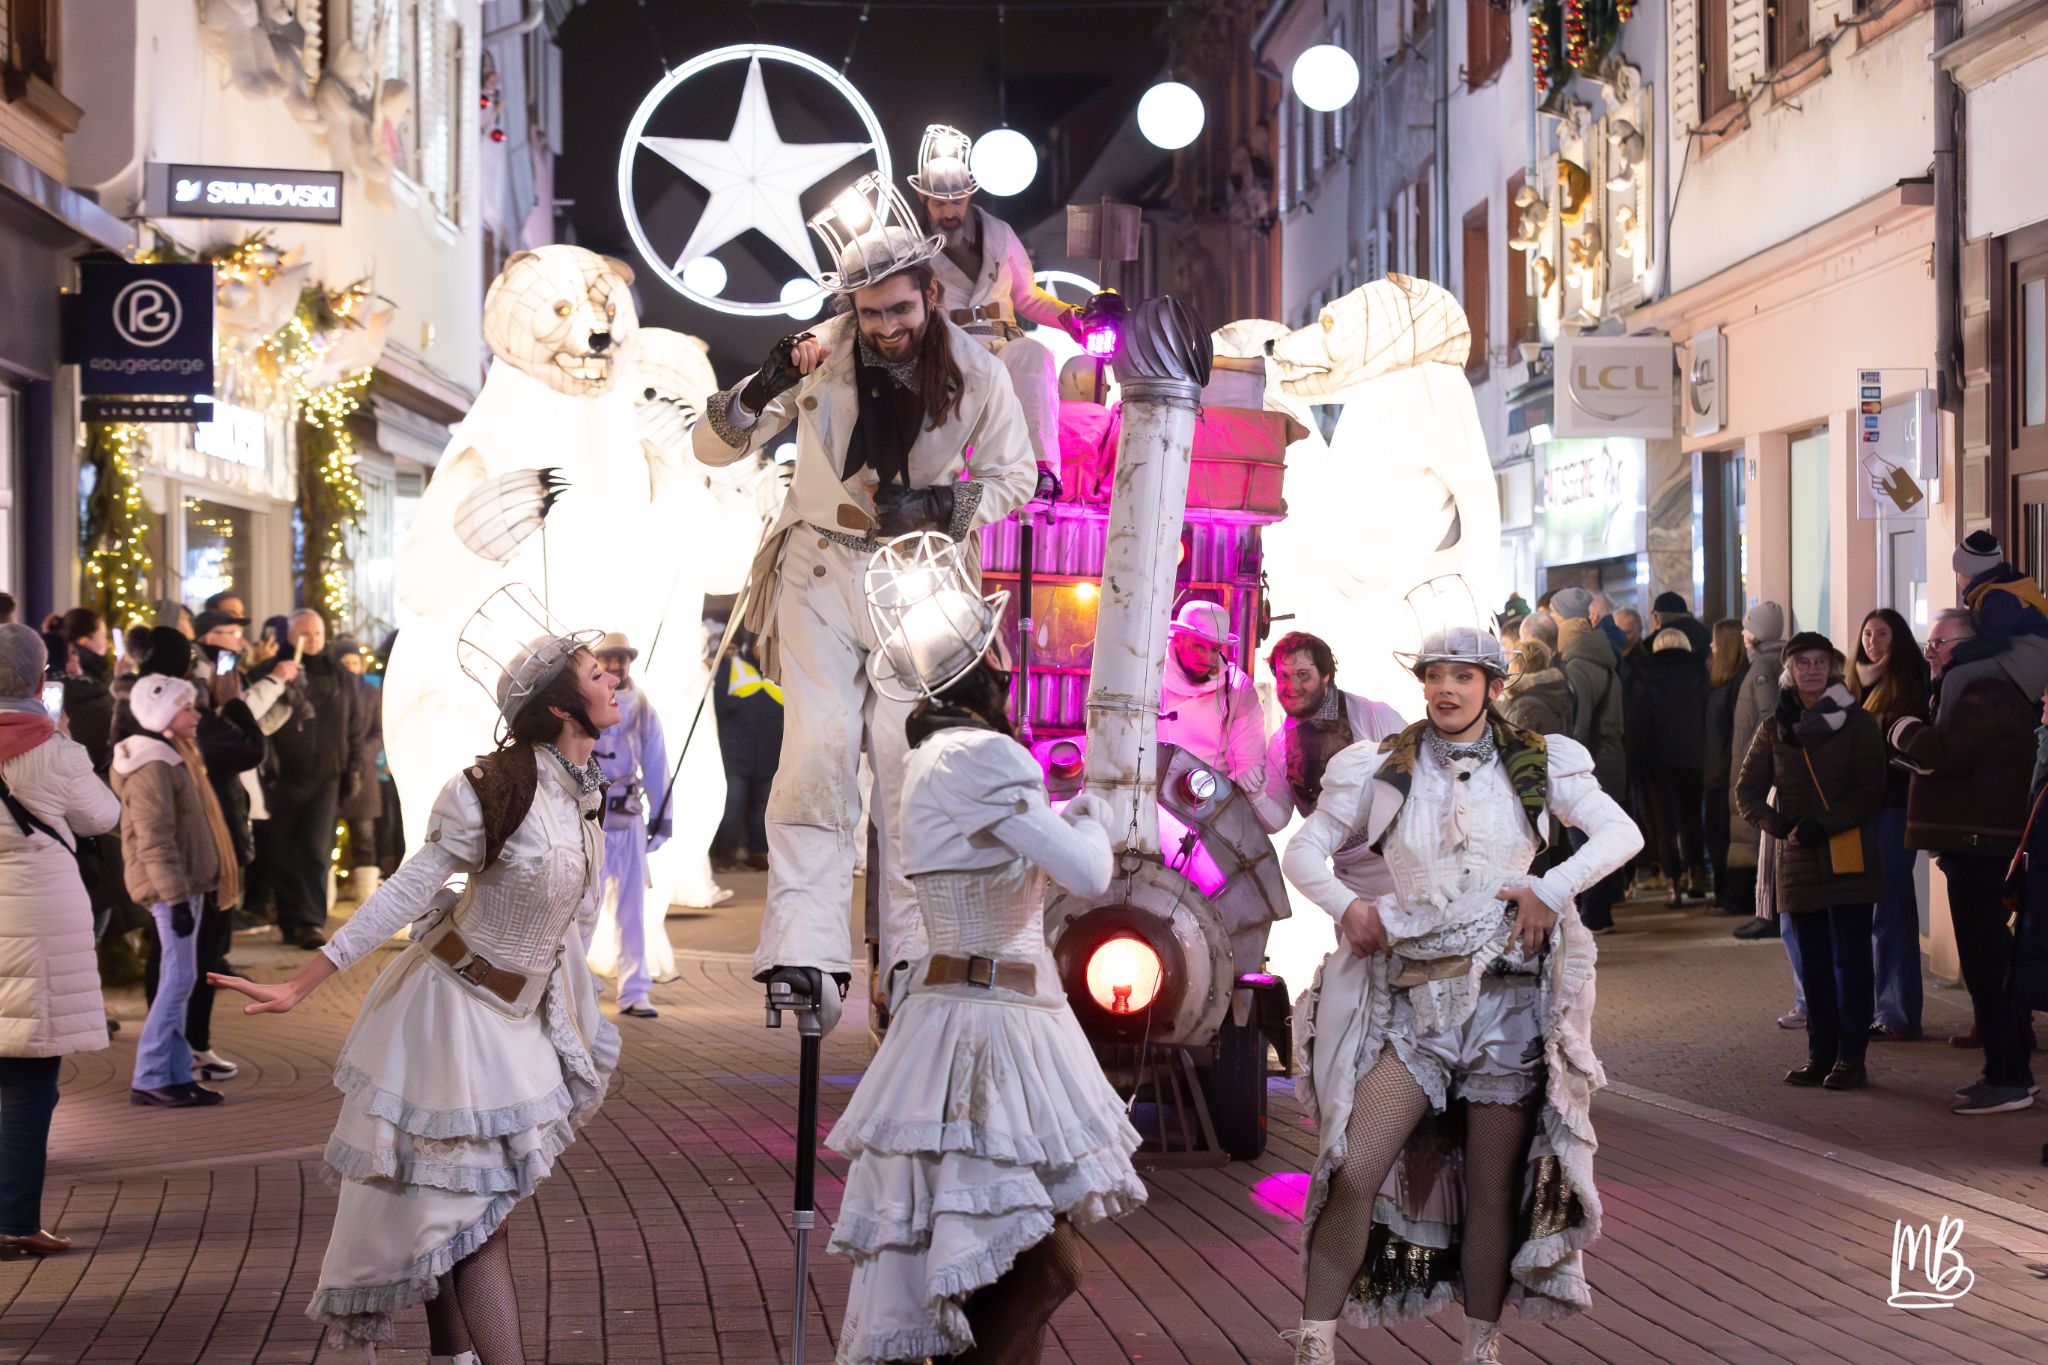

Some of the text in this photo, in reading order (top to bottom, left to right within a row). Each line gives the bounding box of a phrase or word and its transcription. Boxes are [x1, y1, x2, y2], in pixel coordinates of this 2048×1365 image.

[206, 180, 336, 208] SWAROVSKI
[1578, 365, 1659, 390] LCL
[100, 407, 193, 416] LINGERIE
